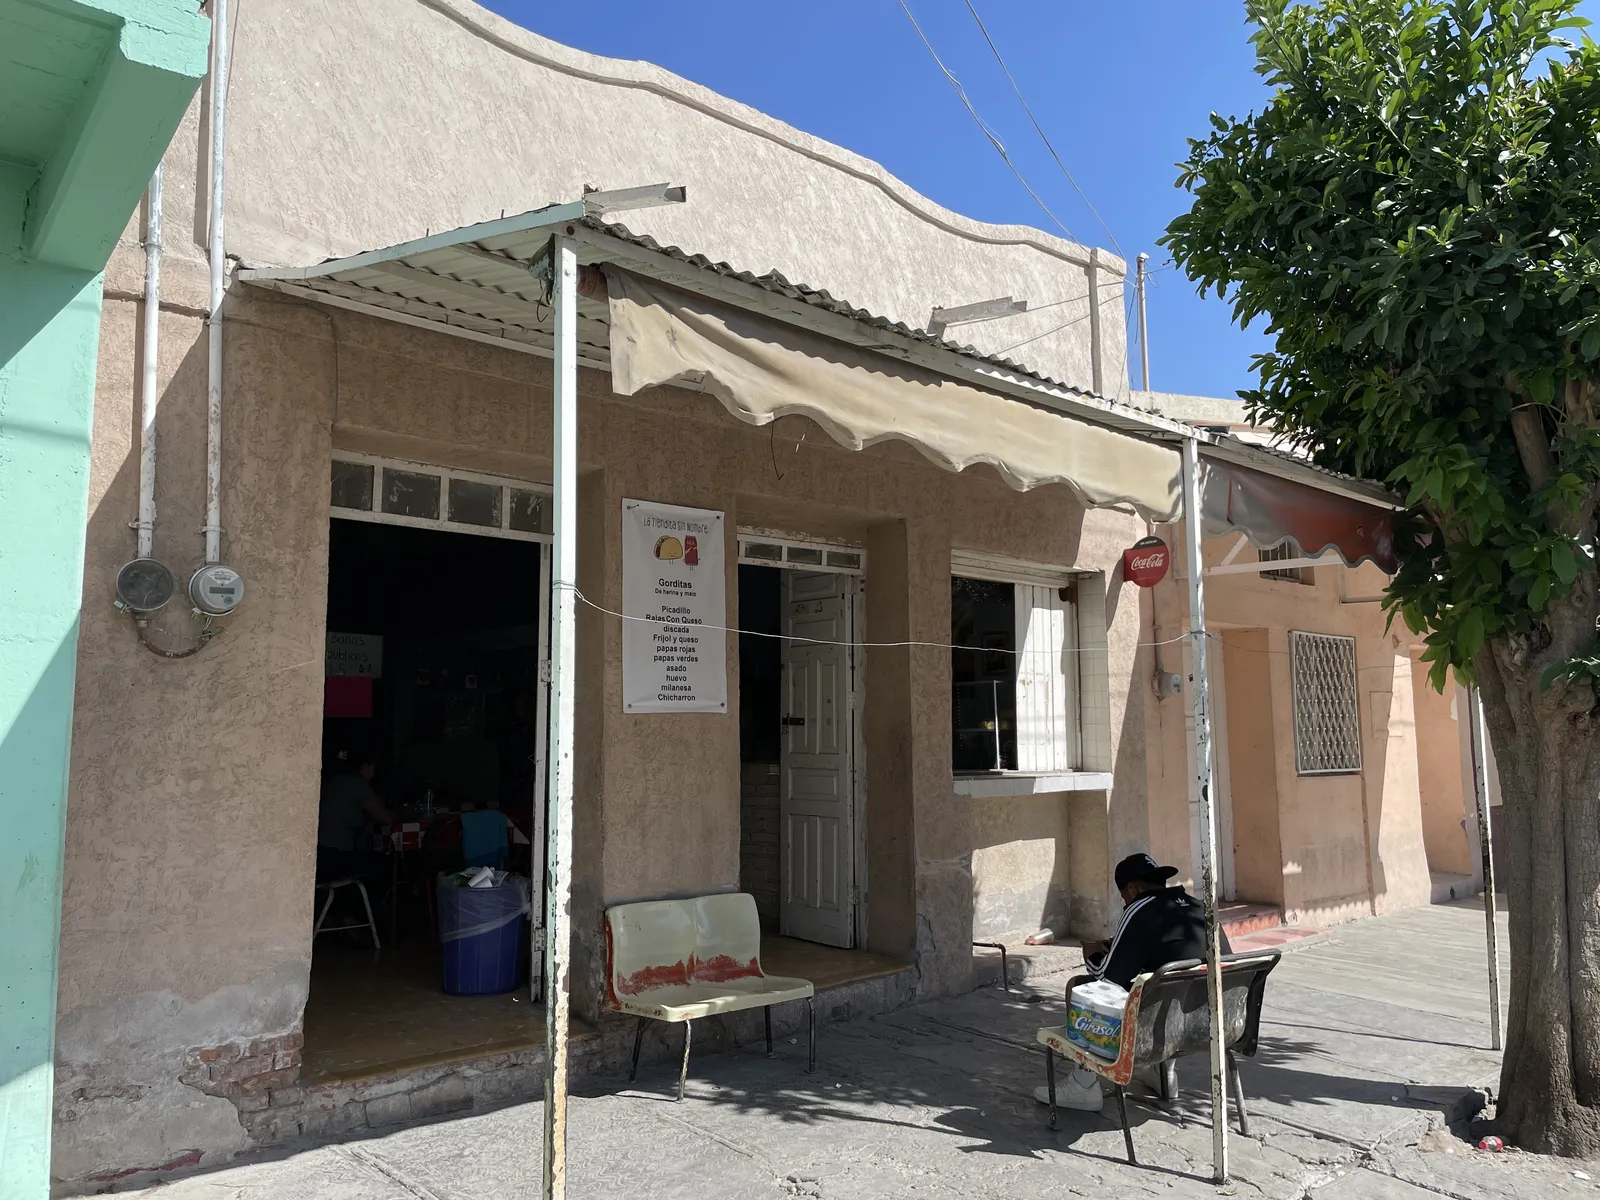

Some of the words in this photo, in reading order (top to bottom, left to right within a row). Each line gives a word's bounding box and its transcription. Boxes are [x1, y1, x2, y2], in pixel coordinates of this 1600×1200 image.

[658, 578, 692, 588] Gorditas
[663, 588, 679, 596] harina
[661, 605, 690, 614] Picadillo
[645, 613, 665, 623] Rajas
[666, 615, 680, 623] Con
[682, 616, 702, 624] Queso
[663, 625, 689, 633] discada
[653, 634, 671, 643] Frijol
[679, 646, 696, 654] rojas
[653, 655, 675, 663] papas
[657, 693, 696, 701] Chicharron
[1074, 1016, 1121, 1037] Girasol
